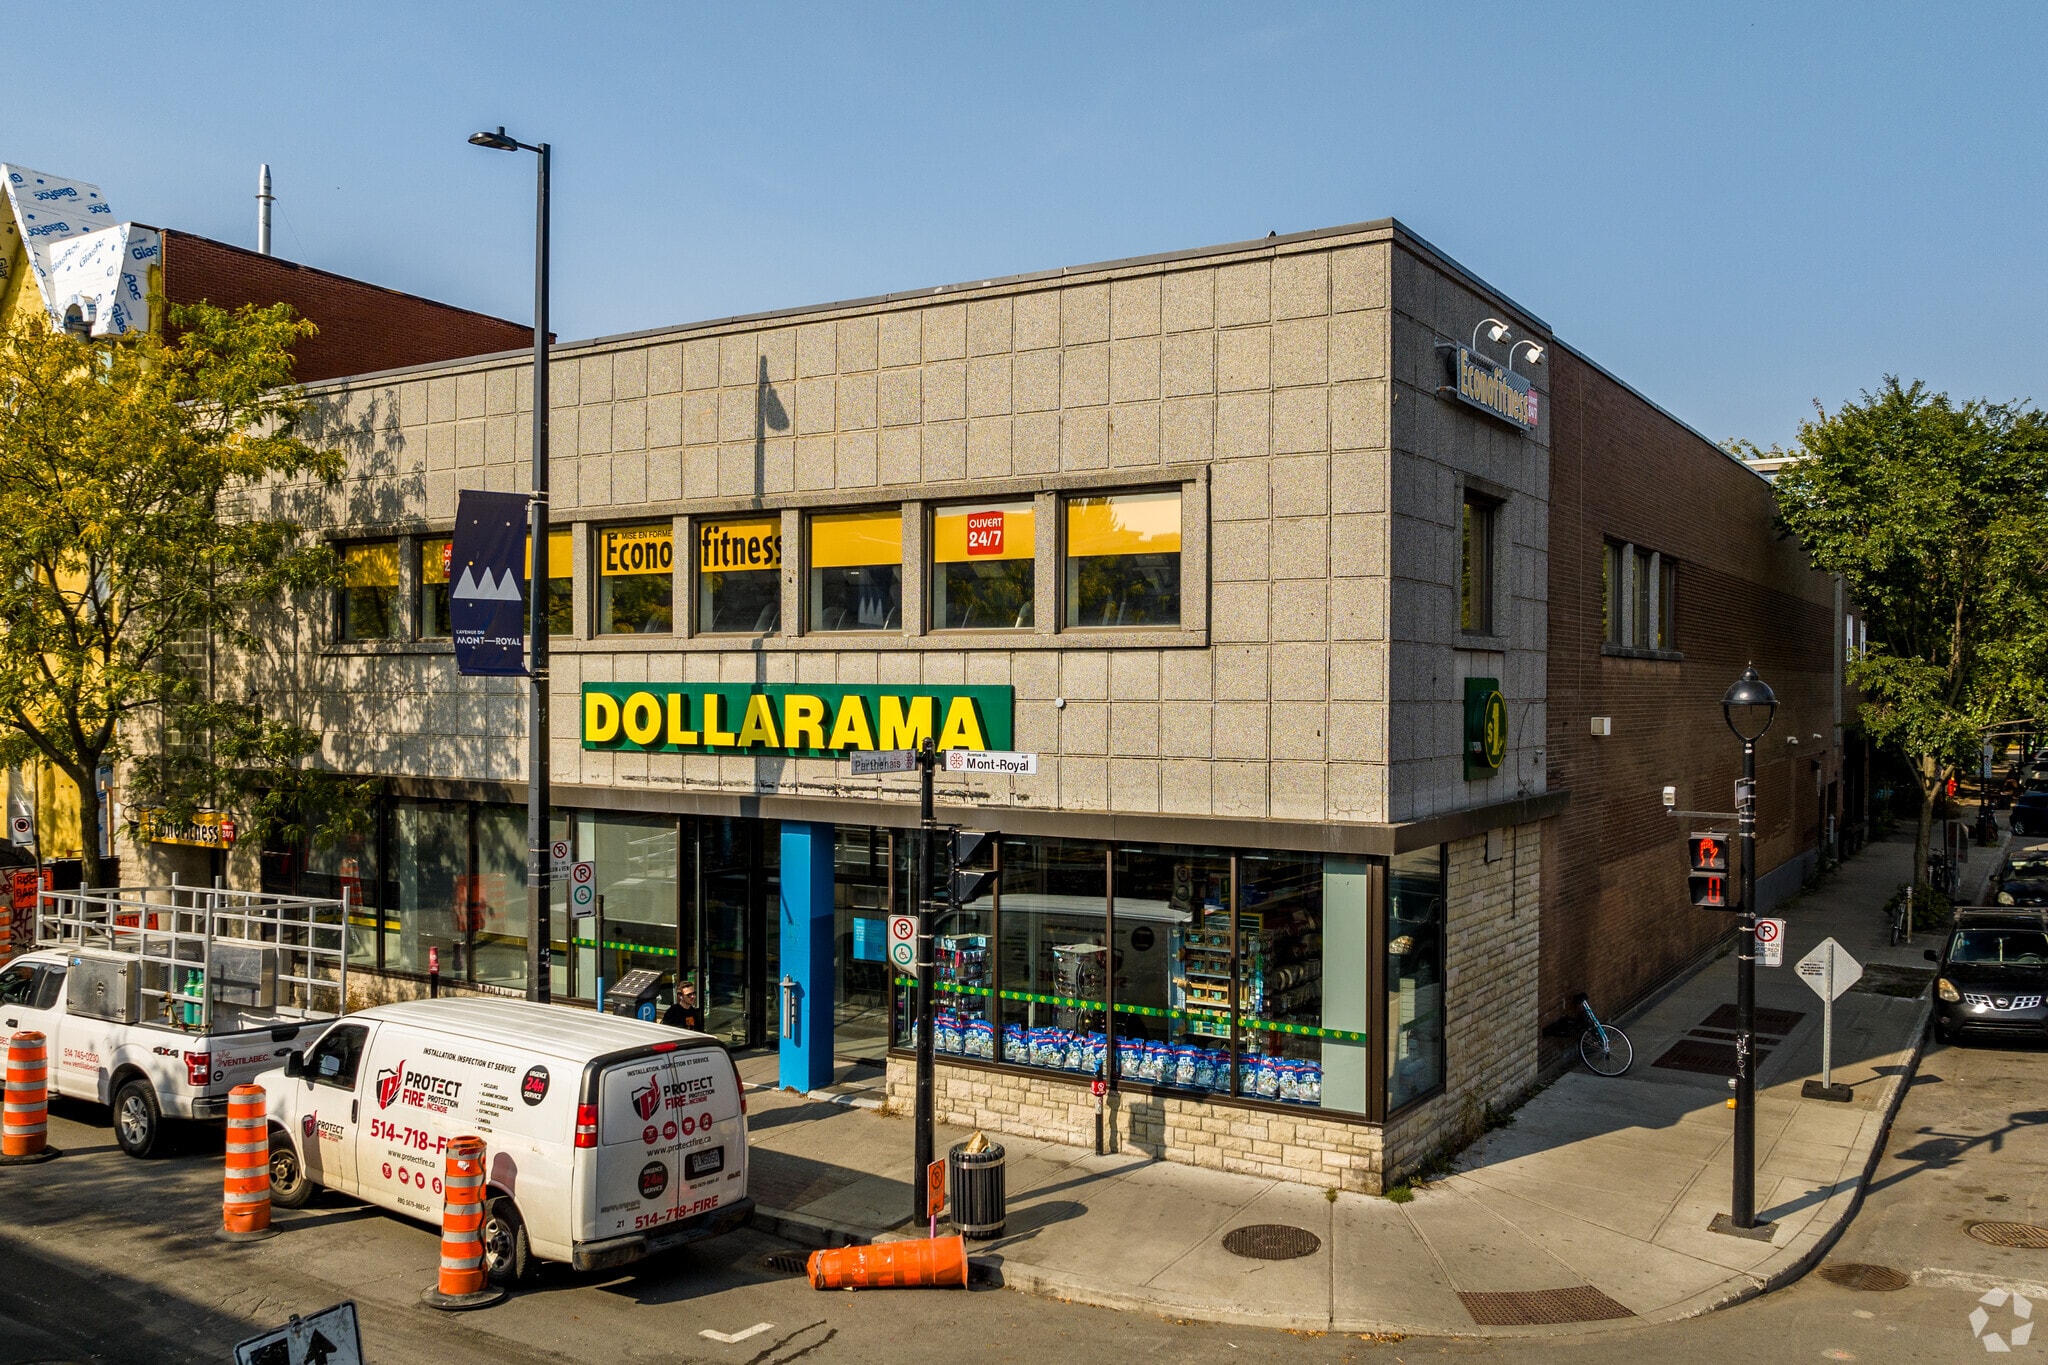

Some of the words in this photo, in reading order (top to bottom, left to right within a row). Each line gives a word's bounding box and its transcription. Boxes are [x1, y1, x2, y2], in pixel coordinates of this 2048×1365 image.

[1461, 348, 1529, 425] Econofitness
[969, 517, 1003, 529] OUVERT
[622, 532, 637, 540] MISE
[639, 531, 648, 539] EN
[649, 529, 673, 538] FORME
[969, 530, 1002, 547] 24/7
[606, 532, 673, 571] Econo
[585, 691, 986, 751] DOLLARAMA
[855, 758, 901, 771] Parthenais
[966, 757, 1029, 773] Mont-Royal
[457, 1055, 486, 1068] INSPECTION
[487, 1061, 494, 1069] ET
[494, 1062, 516, 1074] SERVICE
[693, 1057, 709, 1065] SERVICE
[405, 1071, 462, 1098] PROTECT
[663, 1076, 713, 1097] PROTECT
[402, 1088, 425, 1108] FIRE
[428, 1094, 459, 1108] PROTECTION
[665, 1095, 686, 1110] FIRE
[317, 1120, 344, 1135] PROTECT
[371, 1118, 449, 1155] 514-718-F
[646, 1135, 711, 1157] www.protectfire.ca
[388, 1149, 436, 1168] www.protectfire.ca
[643, 1184, 663, 1195] SERVICE
[635, 1194, 719, 1229] 514-718-FIRE
[617, 1220, 625, 1229] 21
